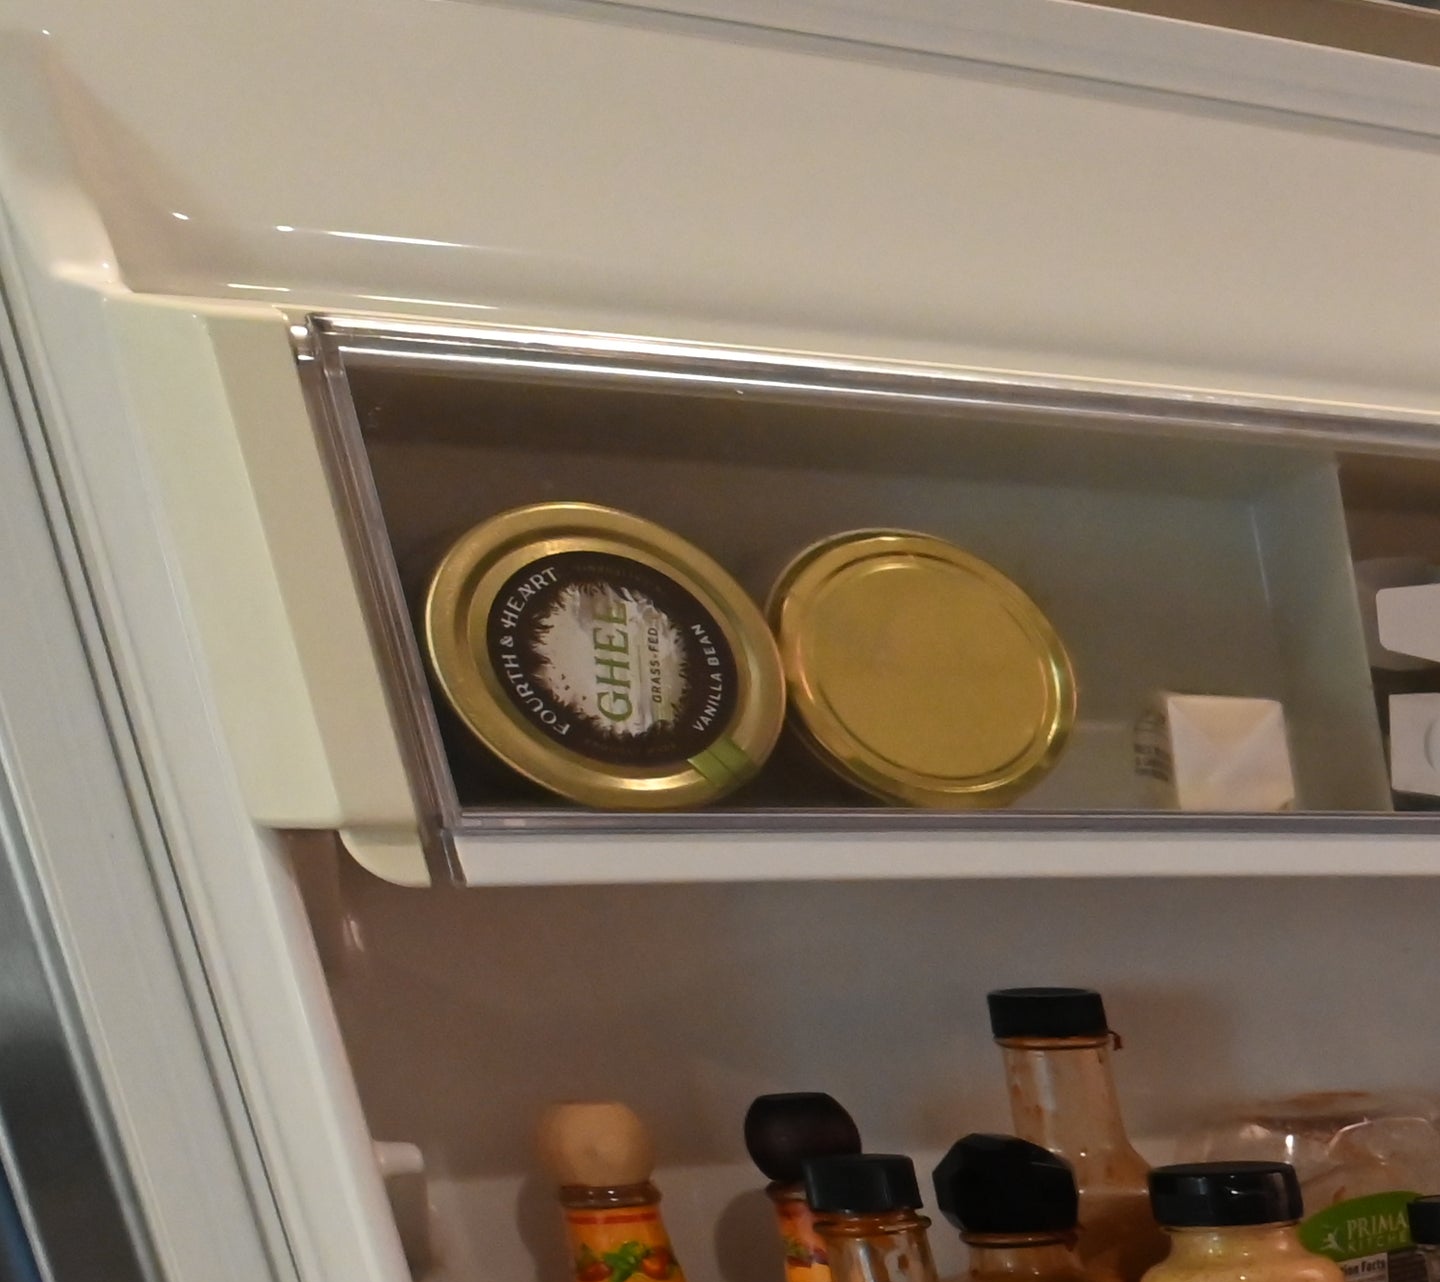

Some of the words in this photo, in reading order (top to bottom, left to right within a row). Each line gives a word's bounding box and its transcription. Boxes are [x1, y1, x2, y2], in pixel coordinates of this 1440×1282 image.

[501, 567, 558, 627] HEART
[500, 635, 514, 647] &
[593, 602, 633, 722] GHEE
[648, 628, 663, 703] GRASS-FED
[691, 624, 720, 666] BEAN
[502, 653, 571, 735] FOURTH
[692, 672, 723, 732] VANILLA
